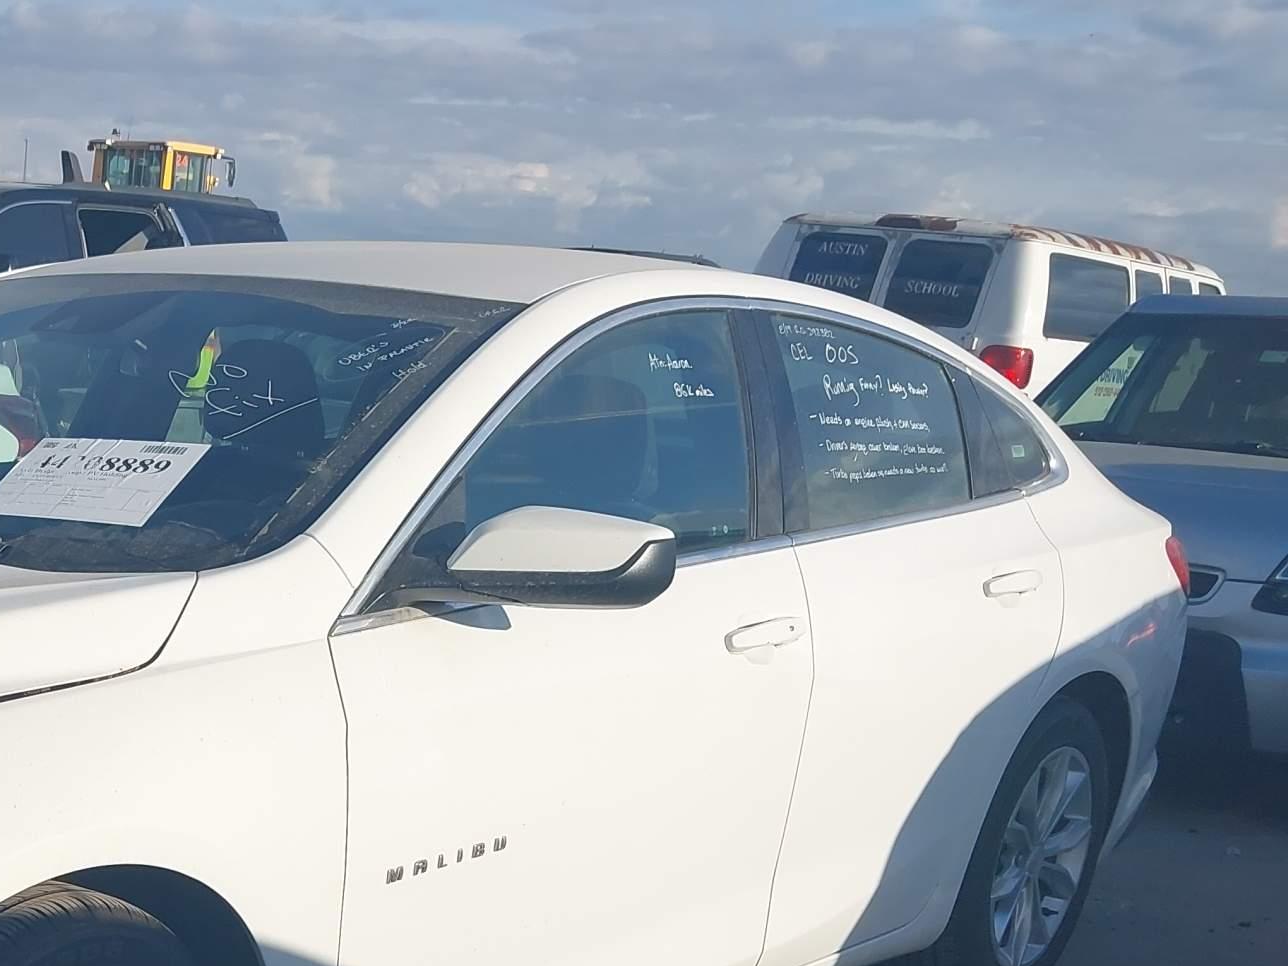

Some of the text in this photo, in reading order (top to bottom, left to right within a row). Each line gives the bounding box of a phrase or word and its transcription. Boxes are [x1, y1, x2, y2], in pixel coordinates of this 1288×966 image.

[818, 241, 869, 256] AUSTIN
[803, 271, 960, 298] DRIVING SCHOOL
[385, 835, 508, 885] MALIBU
